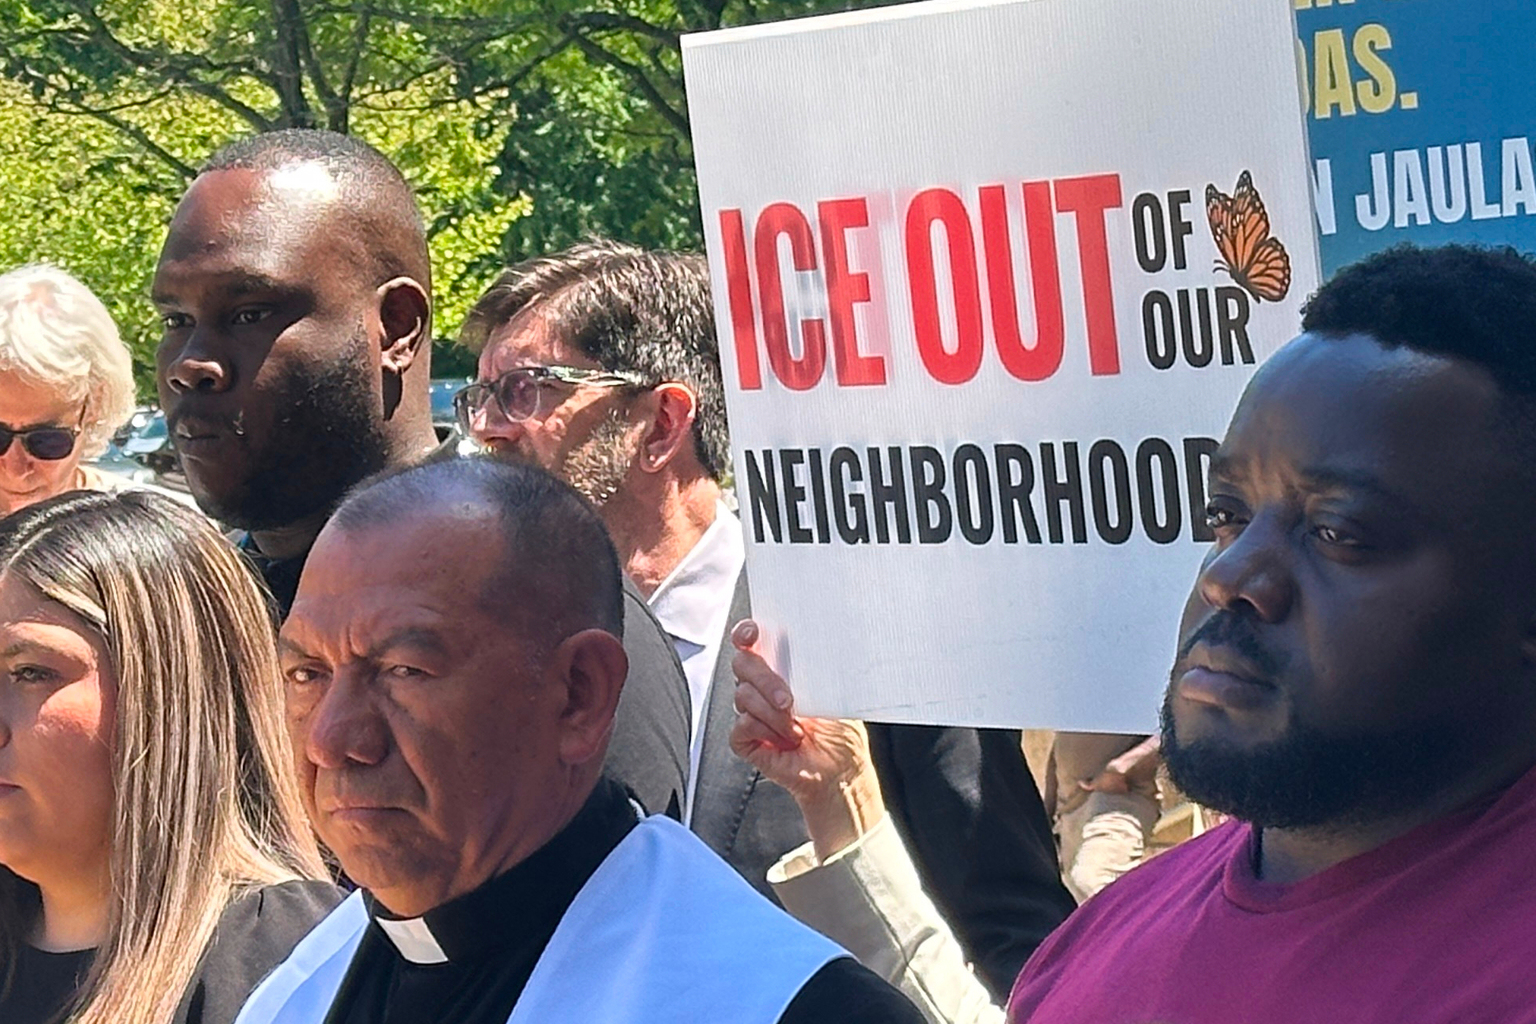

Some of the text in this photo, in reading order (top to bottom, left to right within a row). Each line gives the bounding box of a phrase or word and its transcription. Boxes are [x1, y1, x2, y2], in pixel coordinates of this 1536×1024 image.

[1296, 22, 1419, 119] AS.
[1132, 189, 1193, 274] OF
[1354, 137, 1536, 231] JAULA
[719, 173, 1123, 392] ICE OUT
[1141, 285, 1256, 370] OUR
[744, 436, 1222, 546] NEIGHBORHOOD
